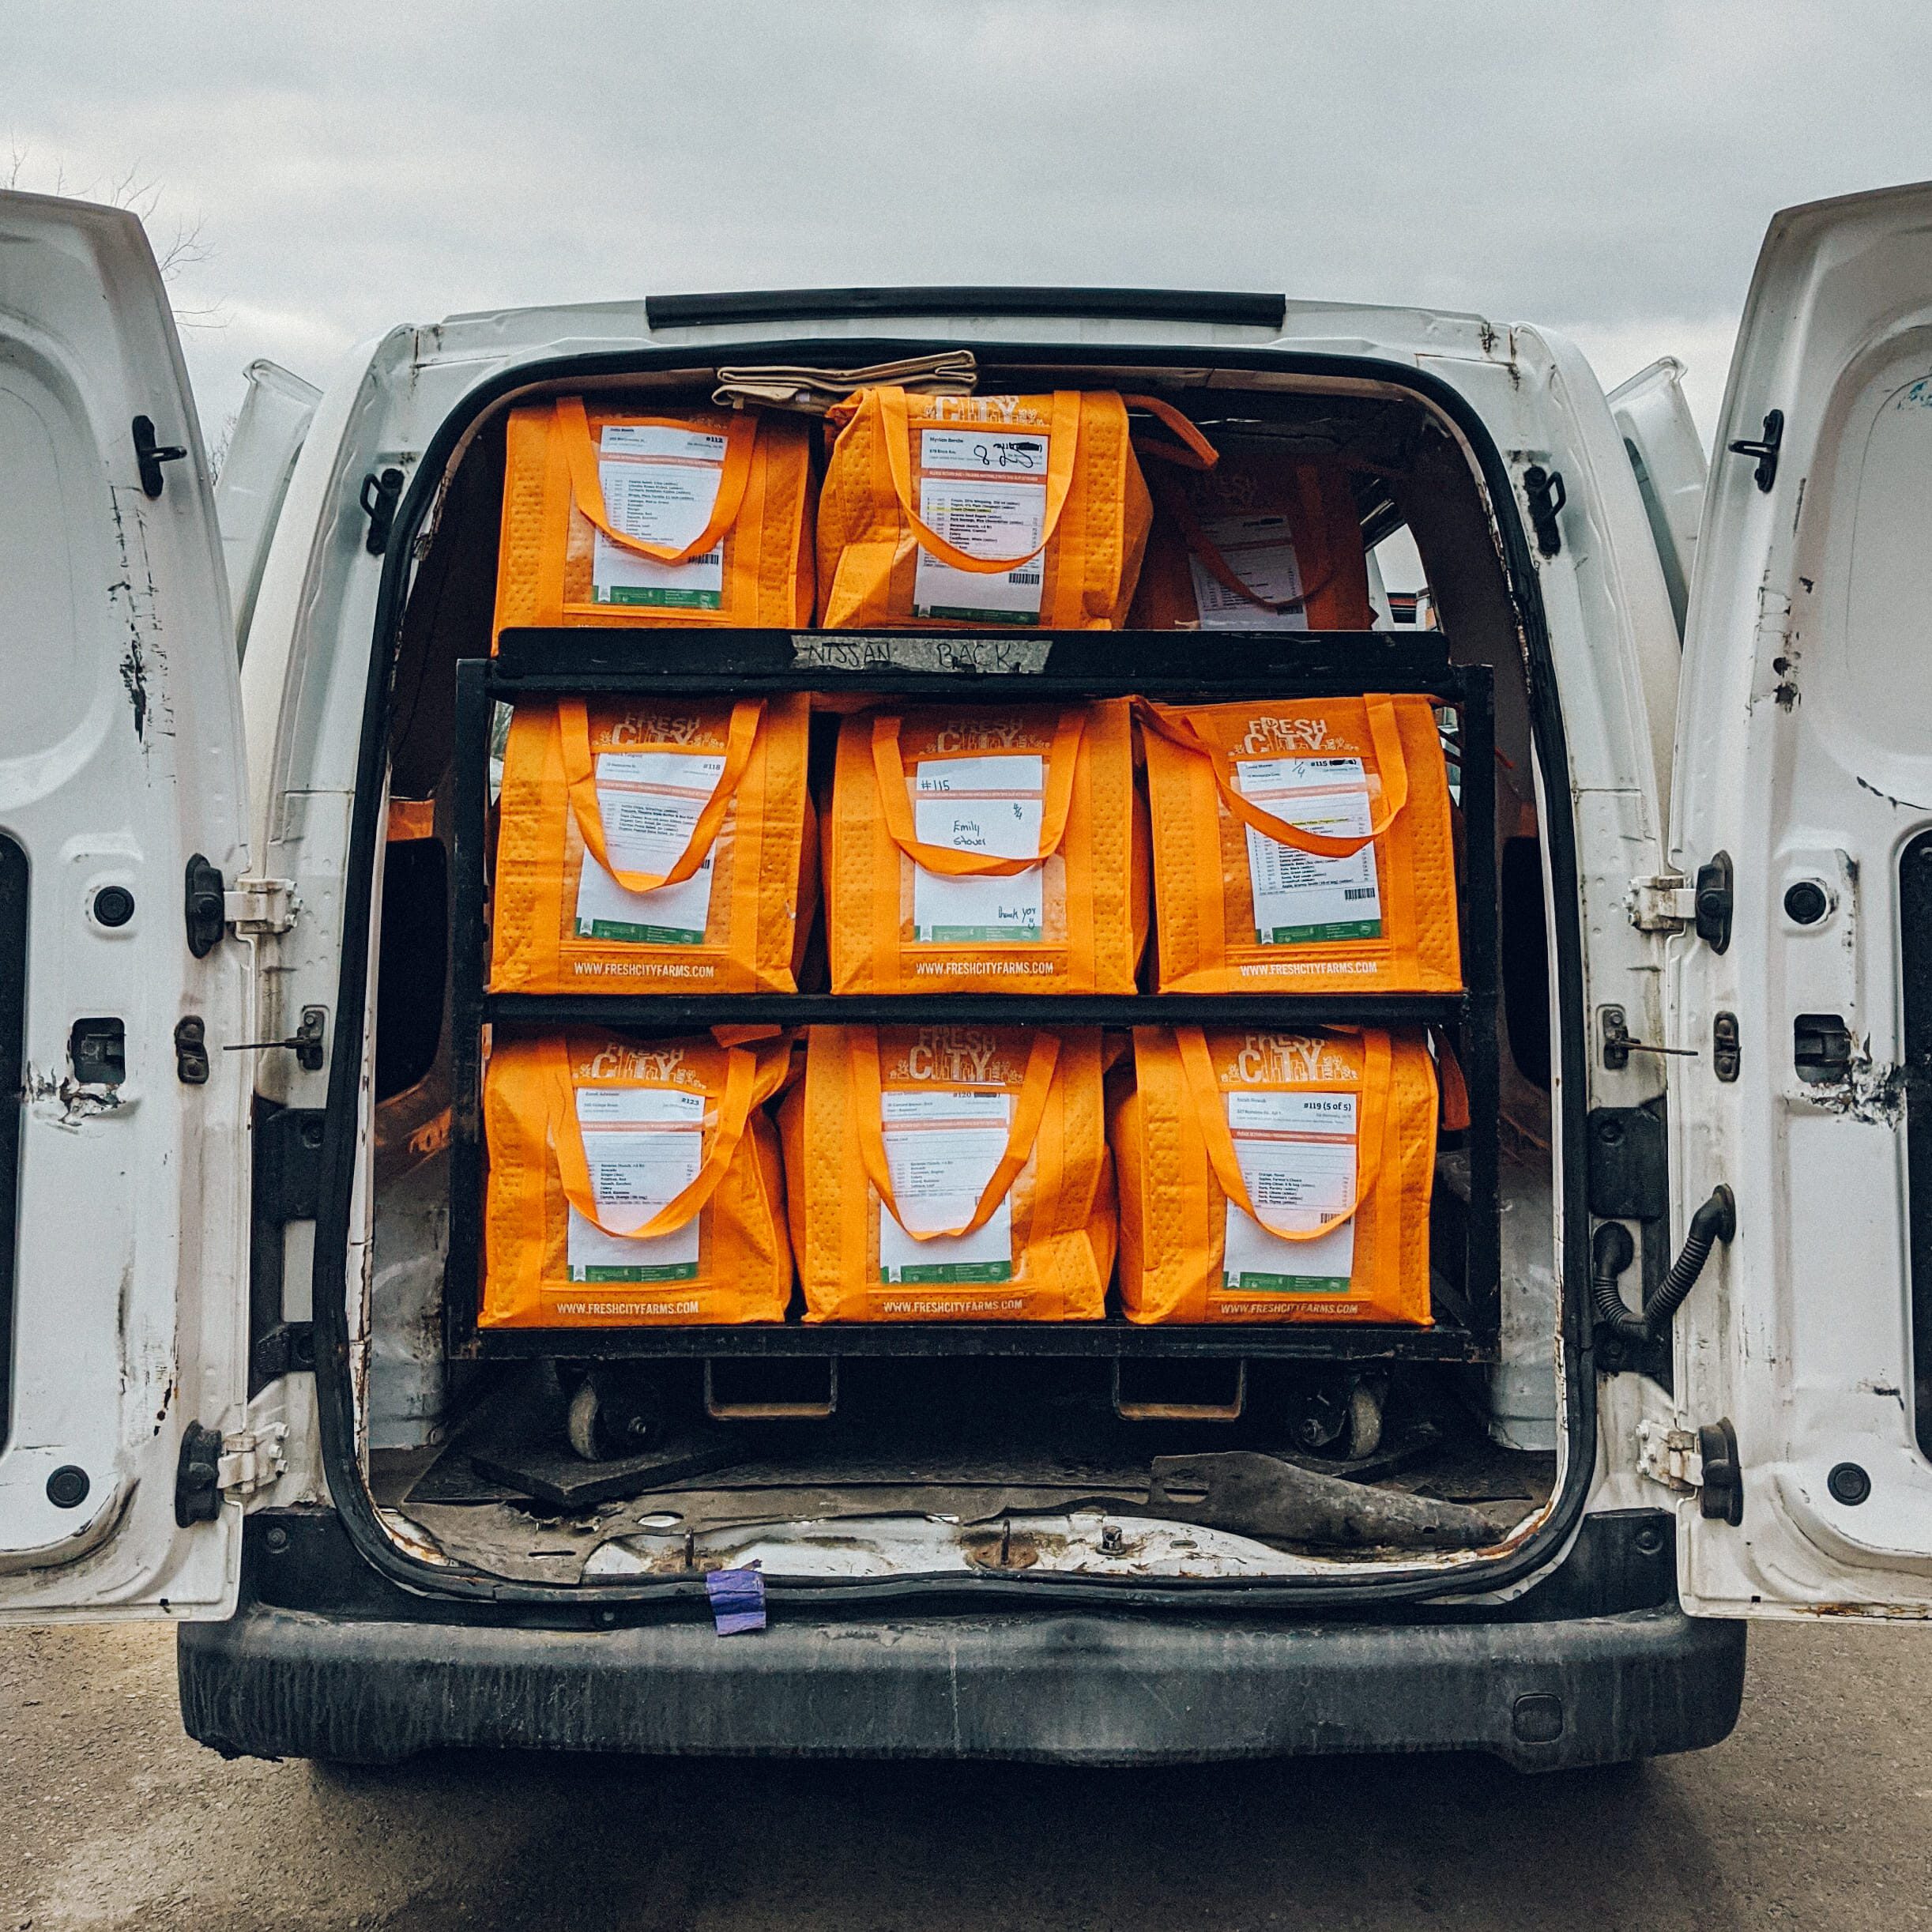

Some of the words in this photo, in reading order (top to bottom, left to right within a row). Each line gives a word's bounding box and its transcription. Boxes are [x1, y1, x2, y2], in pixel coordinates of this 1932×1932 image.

[936, 396, 1019, 424] CITY
[936, 643, 1011, 668] BACK
[612, 723, 697, 744] CITY
[1248, 717, 1327, 736] FRESH
[937, 729, 1020, 753] CITY
[1244, 732, 1325, 755] CITY
[921, 779, 951, 791] #115
[953, 819, 980, 837] Emily
[574, 962, 714, 977] WWW.FRESHCITYFARMS.COM
[916, 962, 1053, 975] WWW.FRESHCITYFARMS.COM
[1240, 961, 1377, 977] WWW.FRESHCITYFARMS.COM
[592, 1053, 680, 1082] CITY
[909, 1046, 994, 1082] CITY
[1238, 1045, 1323, 1083] CITY
[681, 1097, 699, 1105] #123
[1323, 1102, 1331, 1111] (5
[556, 1301, 699, 1314] WWW.FRESHCITYFARMS.COM
[883, 1299, 1022, 1313] WWW.FRESHCITYFARMS.COM
[1221, 1303, 1358, 1314] WWW.FRESHCITYFARMS.COM
